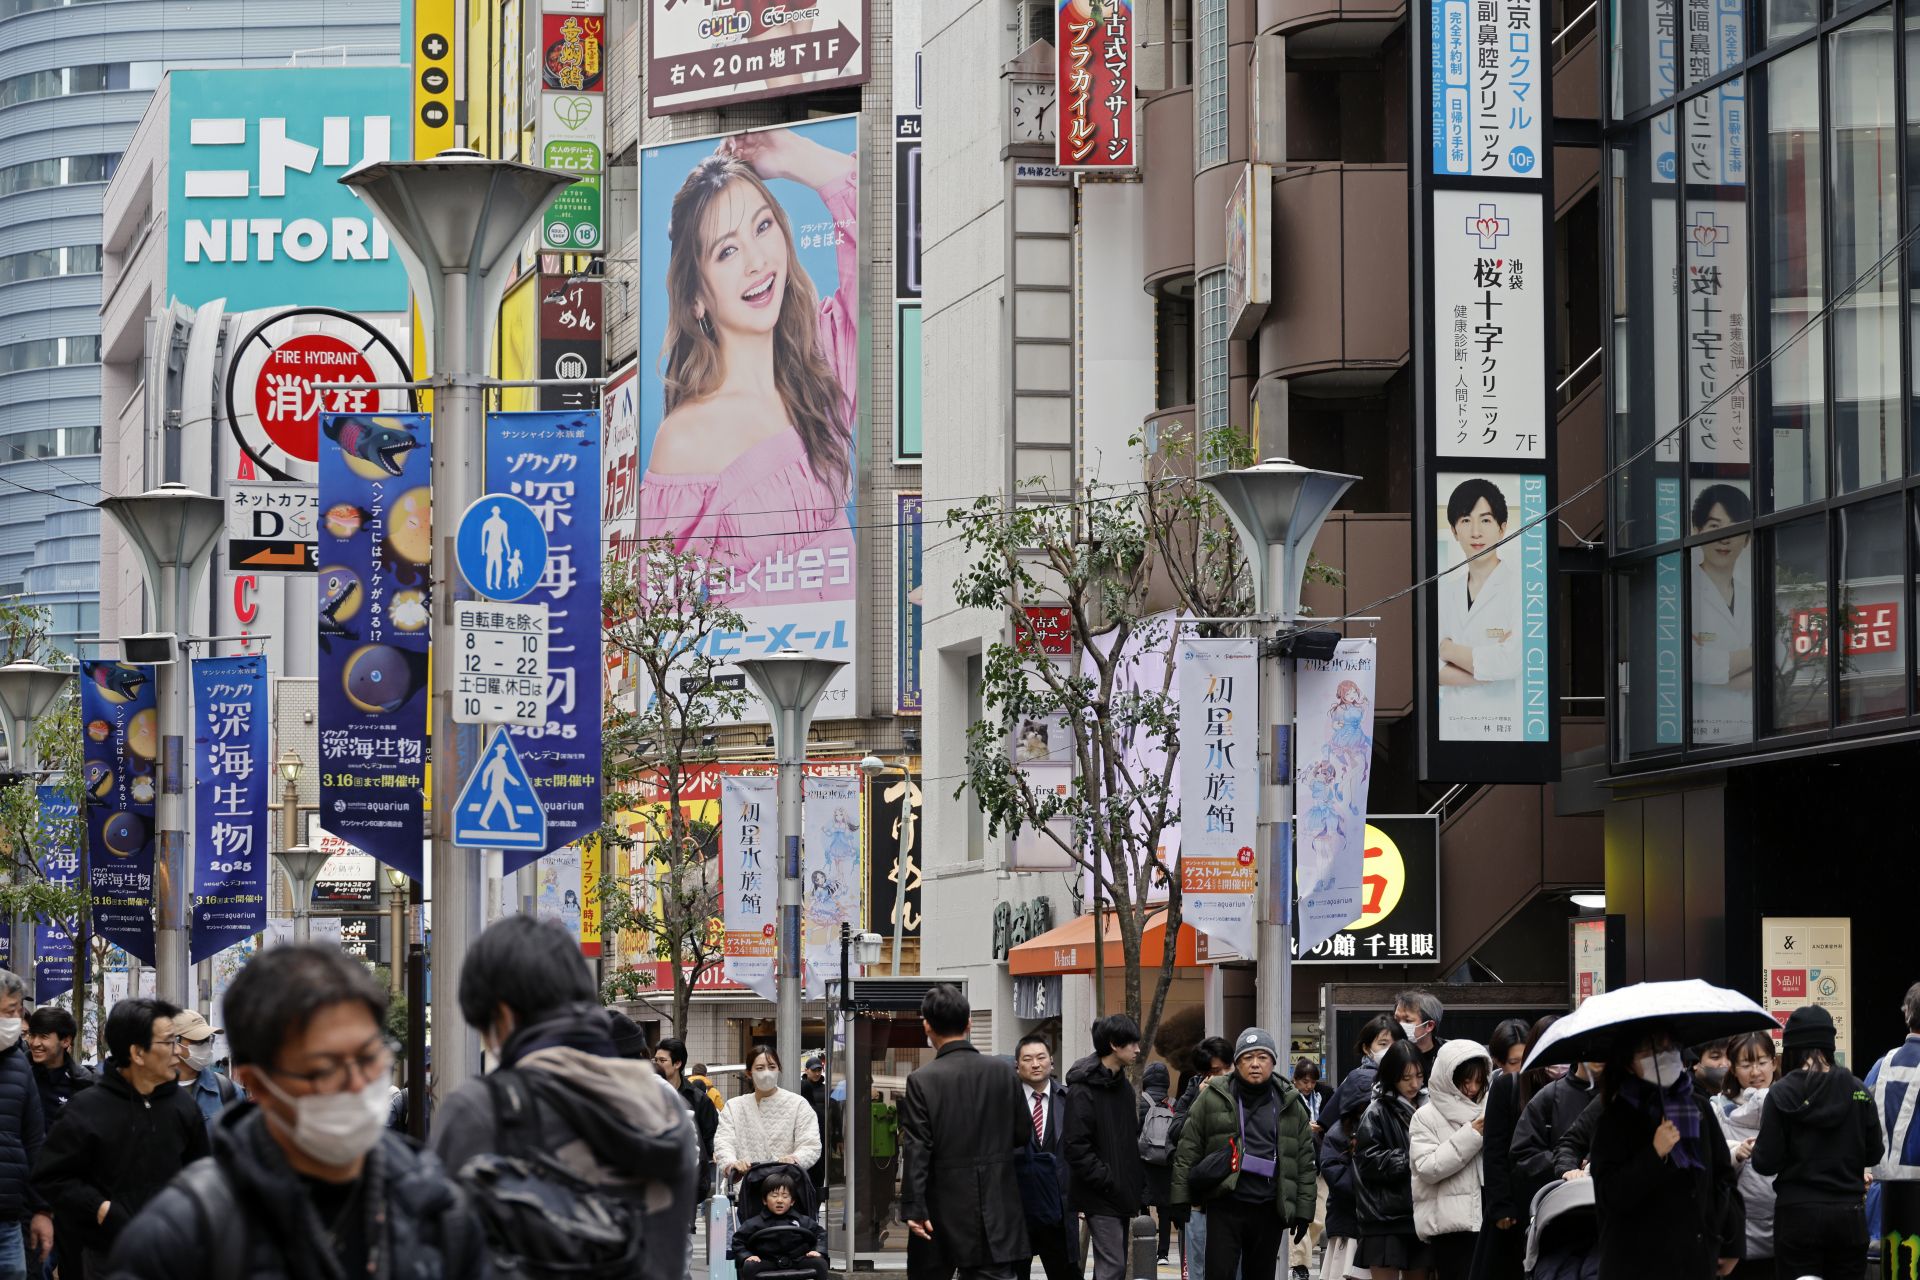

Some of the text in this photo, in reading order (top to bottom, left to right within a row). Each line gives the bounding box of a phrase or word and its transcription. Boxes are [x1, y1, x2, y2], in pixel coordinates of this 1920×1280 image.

[698, 11, 752, 39] GUILD
[1450, 11, 1463, 76] 完全予約制
[1507, 0, 1532, 130] 京ロクマル
[1036, 86, 1046, 95] 12
[1068, 20, 1095, 161] プラカイルン
[1478, 0, 1499, 171] 副鼻腔クリニック
[1014, 107, 1021, 116] 9
[1038, 132, 1045, 141] 6
[1451, 98, 1464, 162] 日帰り手術
[185, 115, 391, 198] ニトリ
[549, 154, 595, 170] エムズ
[1510, 153, 1532, 167] 10F
[184, 217, 390, 263] NITORI
[1508, 258, 1524, 290] 池袋
[275, 350, 360, 366] FIRE HYDRANT
[1473, 257, 1503, 445] 桜十字クリニック
[1453, 304, 1469, 444] 健康診断・人間ドック
[266, 373, 372, 422] 消火栓
[502, 430, 586, 439] サンシャイン水族館
[1515, 434, 1538, 451] 7F
[506, 453, 578, 474] ゾクゾク
[1524, 479, 1545, 735] BEAUTY SKIN CLINIC
[460, 611, 543, 631] 自転車を除く
[465, 633, 476, 649] 8
[522, 636, 538, 652] 10
[1018, 629, 1069, 641] マサージ
[465, 654, 481, 672] 12
[517, 657, 538, 675] 22
[206, 684, 253, 698] ゾクゾク
[464, 698, 481, 715] 10
[517, 701, 537, 718] 22
[510, 721, 577, 739] 2025
[322, 737, 421, 760] 深海生物
[1202, 672, 1236, 834] 初星水族館
[207, 701, 254, 856] 深海生物
[367, 800, 410, 813] aquarium
[210, 860, 252, 873] 2025
[738, 801, 762, 915] 初星水族館
[92, 873, 151, 887] 深海生物
[224, 911, 256, 920] aquarium
[1363, 933, 1435, 957] 千里眼
